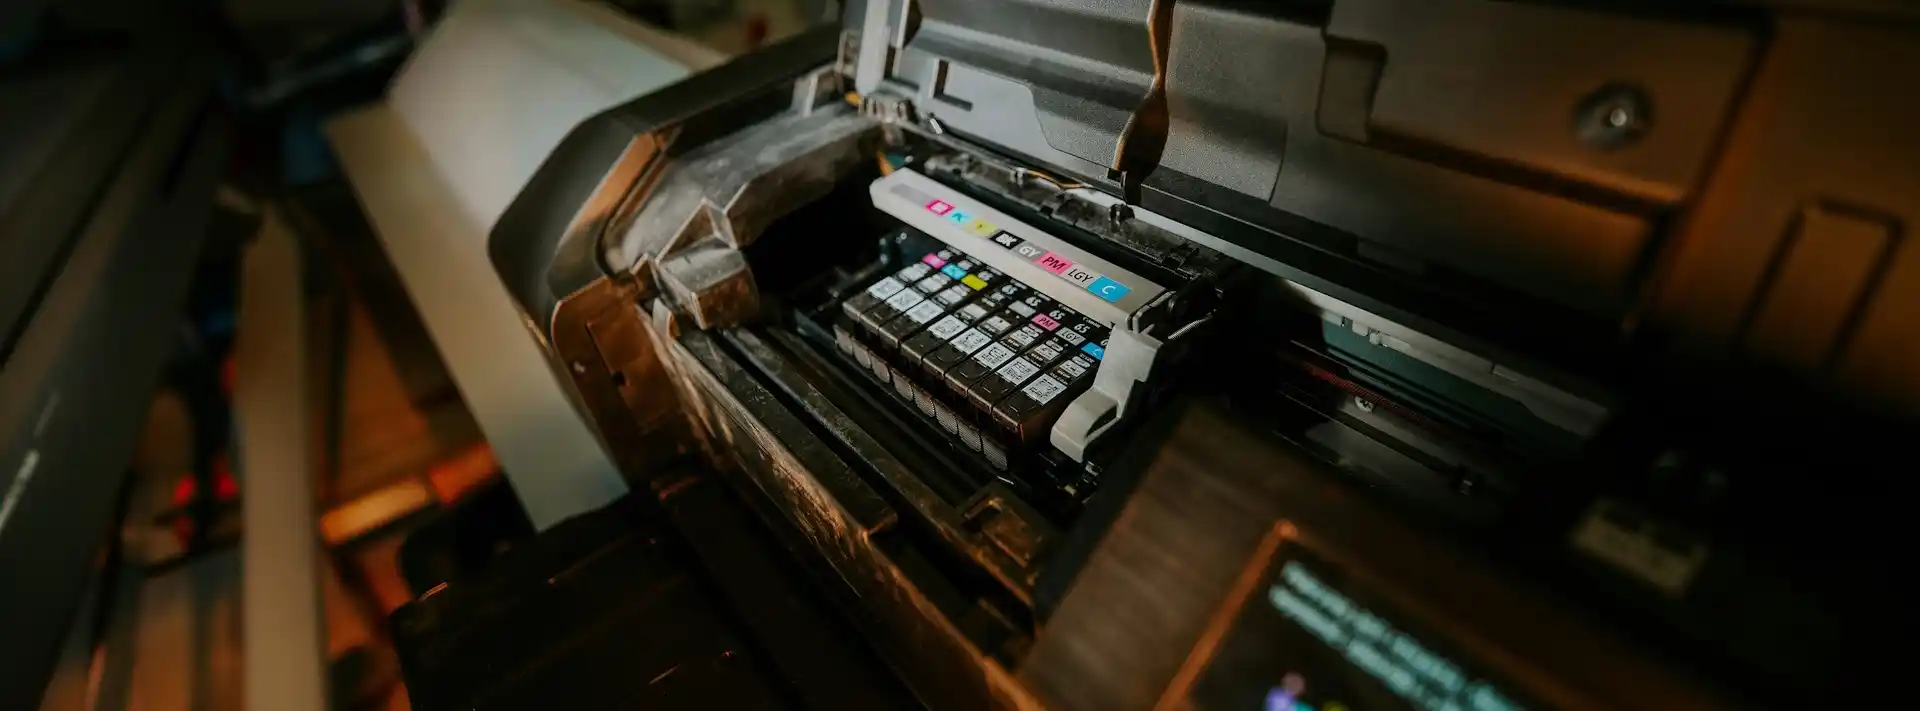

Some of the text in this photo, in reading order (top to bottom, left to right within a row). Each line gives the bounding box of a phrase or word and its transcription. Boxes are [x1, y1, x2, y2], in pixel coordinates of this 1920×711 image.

[1018, 246, 1041, 258] GY
[1042, 256, 1067, 270] PM
[1067, 268, 1094, 283] LGY
[1101, 285, 1116, 295] C
[1049, 309, 1066, 320] 65
[1038, 317, 1054, 328] PM
[1073, 323, 1091, 334] 65
[1061, 330, 1080, 342] LGY
